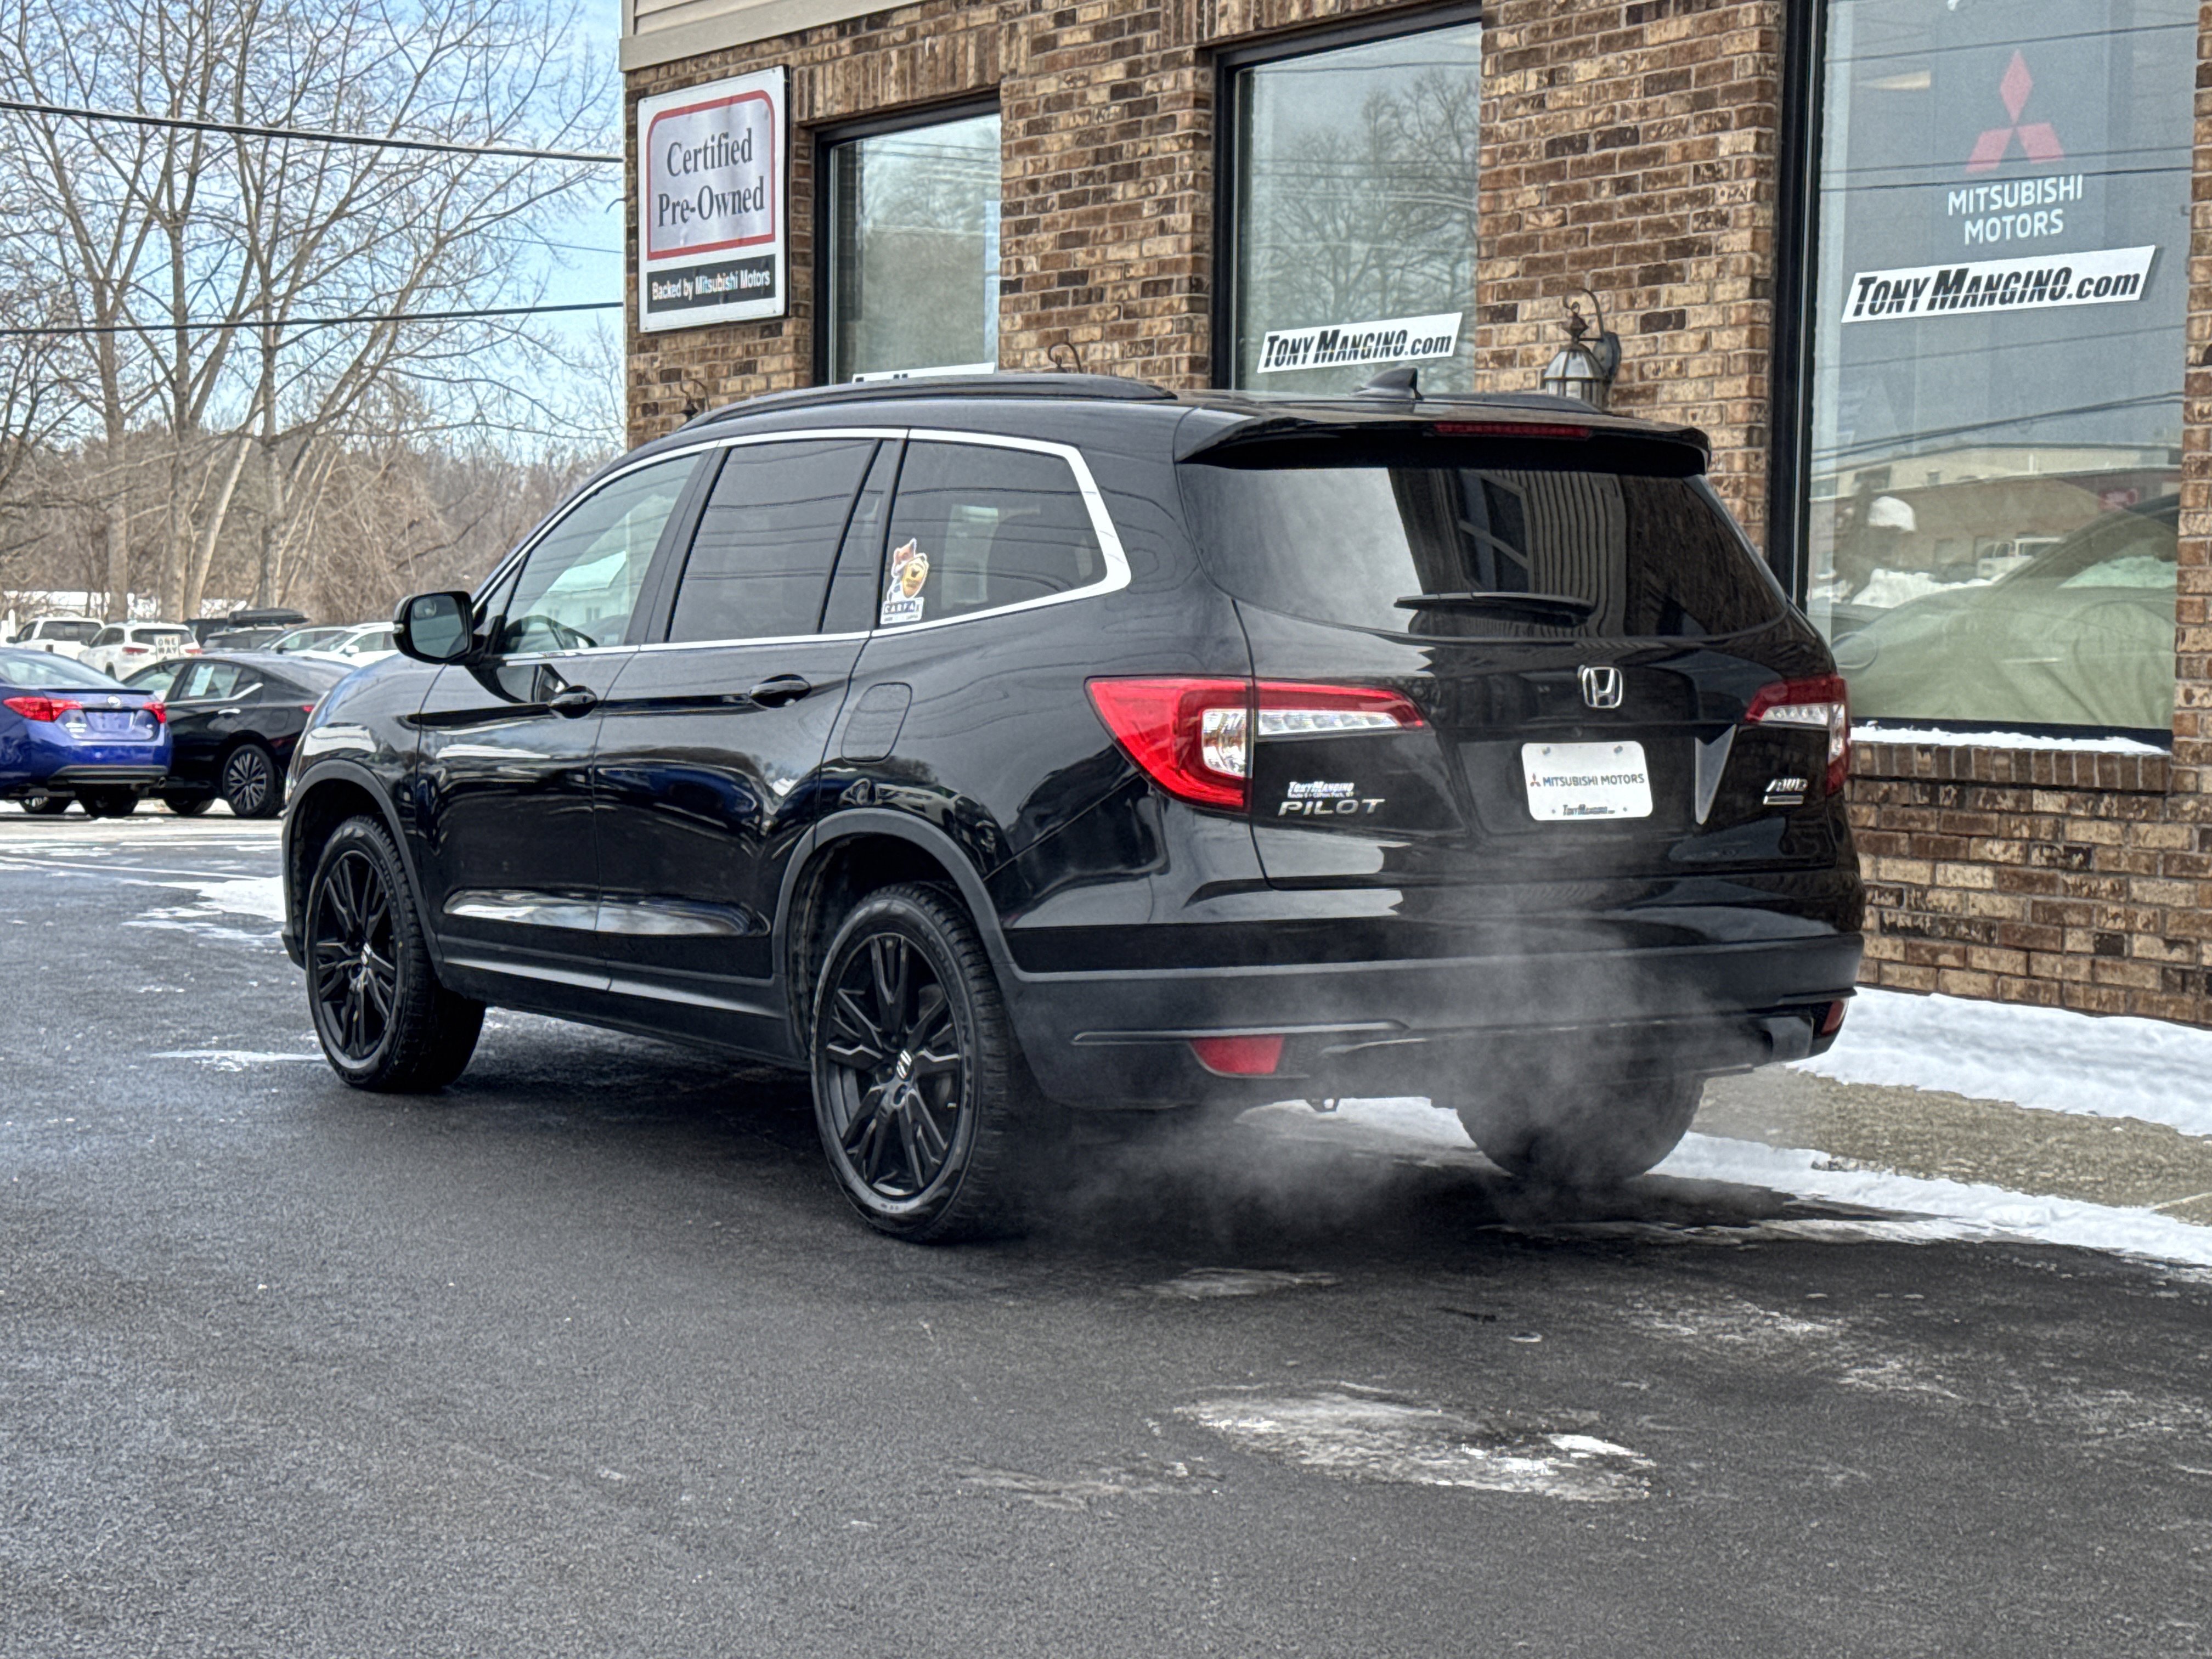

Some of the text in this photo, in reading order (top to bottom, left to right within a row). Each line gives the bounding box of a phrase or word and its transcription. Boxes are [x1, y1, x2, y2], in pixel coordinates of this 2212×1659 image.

[667, 127, 753, 177] Certified
[658, 176, 765, 227] Pre-Owned
[1948, 174, 2083, 216] MITSUBISHI
[1965, 208, 2064, 245] MOTORS
[652, 268, 770, 301] Backed by Mitsubishi Motors
[158, 637, 176, 646] ONE
[1543, 774, 1645, 787] MITSUBISHI MOTORS
[1765, 778, 1808, 792] AWD
[1278, 799, 1386, 816] PILOT
